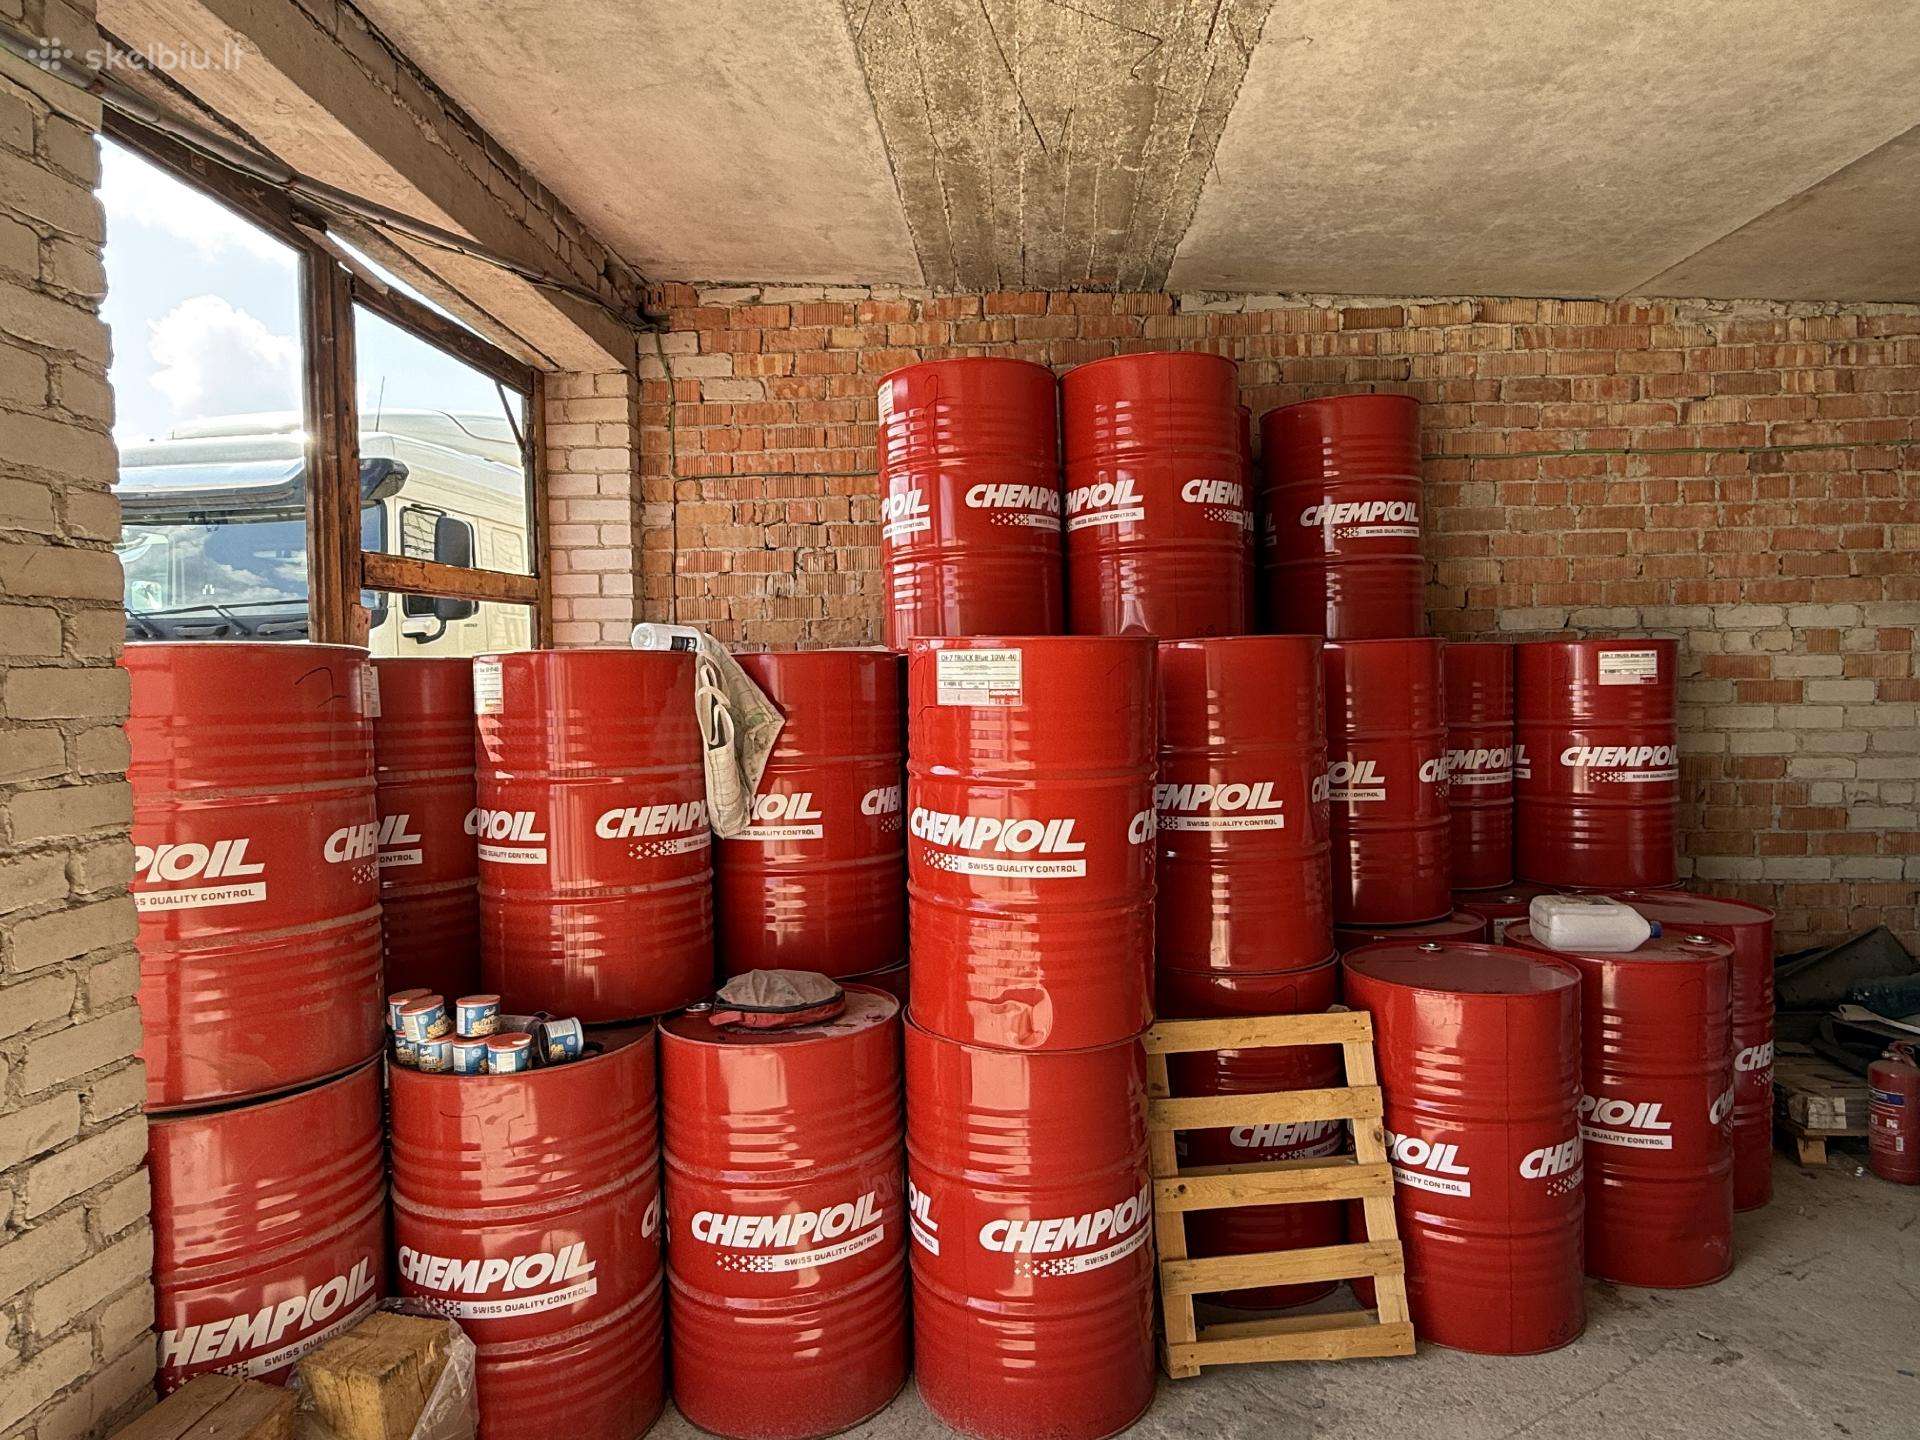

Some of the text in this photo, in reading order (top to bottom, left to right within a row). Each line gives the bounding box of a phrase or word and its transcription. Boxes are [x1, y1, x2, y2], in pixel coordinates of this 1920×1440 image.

[965, 484, 1061, 516] CHEMPIO
[1066, 479, 1144, 515] MPIOIL
[1300, 501, 1418, 526] CHEMPIOIL
[1153, 782, 1284, 811] EMPIOIL
[477, 807, 547, 842] PIOIL
[910, 806, 1086, 853] CHEMPIOIL
[379, 853, 415, 864] ONTROL
[967, 861, 1078, 874] SWISS QUALITY CONTROL
[150, 893, 198, 906] QUALITY
[200, 887, 256, 901] CONTROL
[1577, 1094, 1673, 1130] PIOIL
[1591, 1131, 1626, 1143] QUALITY
[1627, 1135, 1665, 1146] CONTROL
[1423, 1179, 1463, 1192] CONTROL
[691, 1191, 883, 1249] CHEMPIOIL
[783, 1232, 880, 1267] SWISS QUALITY CONTROL
[1084, 1253, 1109, 1267] SWISS
[398, 1241, 597, 1294] CHEMPIOIL
[160, 1256, 376, 1368] HEMPIOIL
[472, 1286, 590, 1314] SWISS QUALITY CONTROL
[263, 1349, 300, 1368] SWISS
